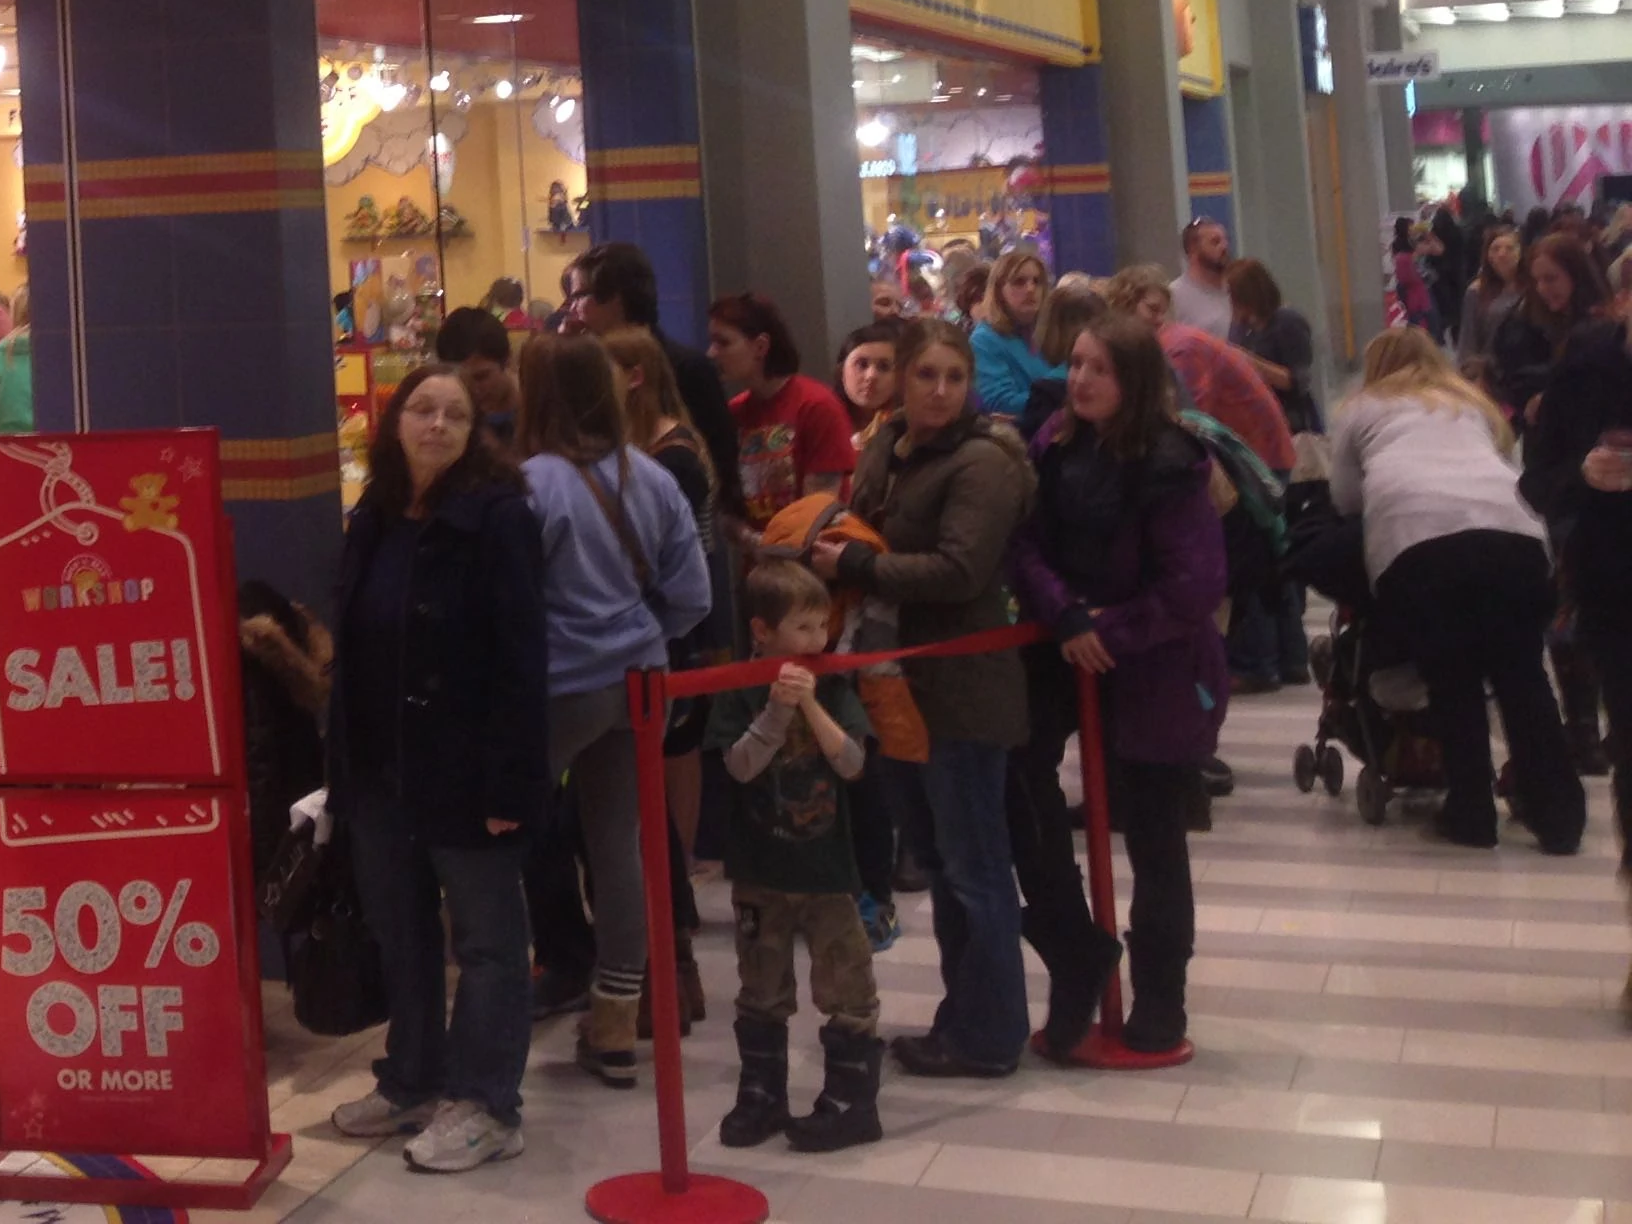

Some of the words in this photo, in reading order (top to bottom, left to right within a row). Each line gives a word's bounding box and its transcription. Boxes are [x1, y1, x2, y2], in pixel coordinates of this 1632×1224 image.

[5, 638, 196, 712] SALE!
[1, 878, 221, 977] 50%
[26, 981, 184, 1059] OFF
[57, 1069, 93, 1091] OR
[101, 1069, 173, 1092] MORE
